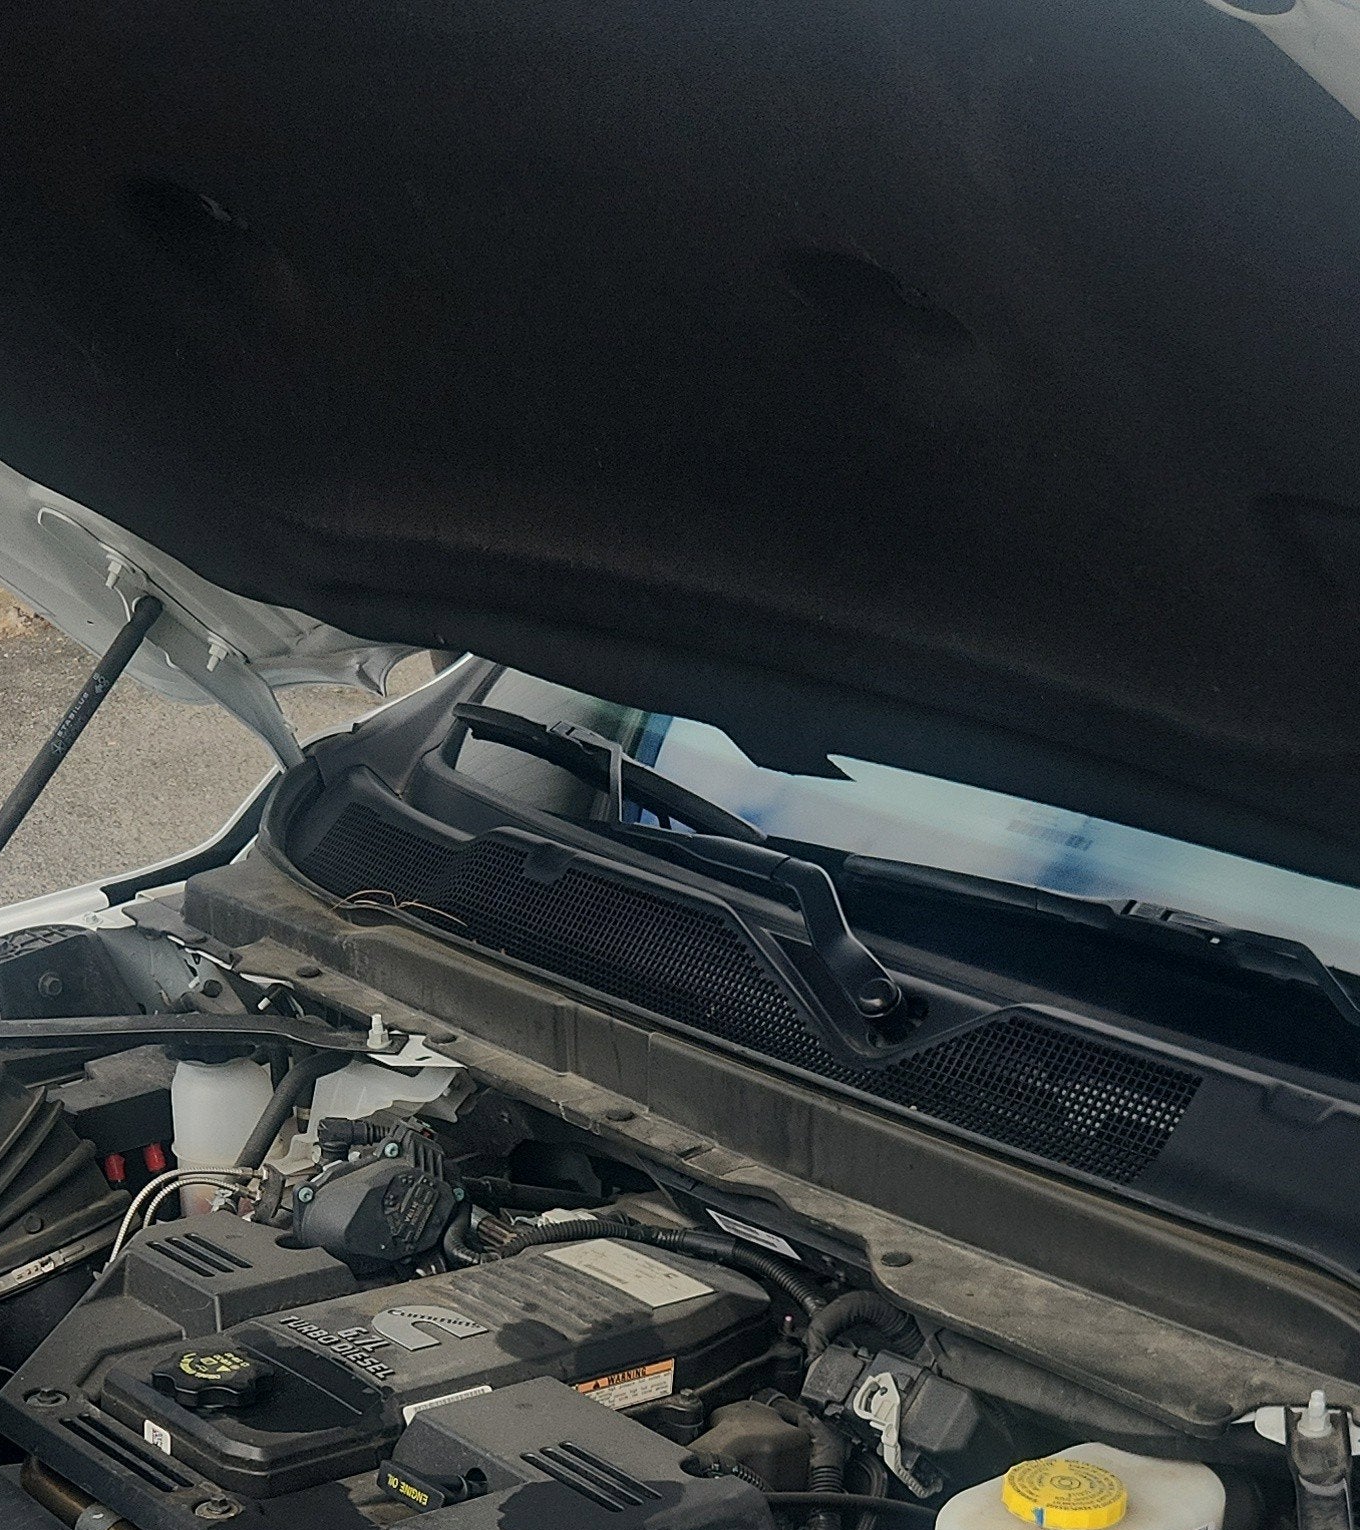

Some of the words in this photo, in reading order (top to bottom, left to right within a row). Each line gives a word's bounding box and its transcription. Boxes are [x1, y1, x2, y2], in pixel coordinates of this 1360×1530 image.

[280, 1315, 338, 1347] TURBO
[330, 1342, 395, 1382] DIESEL
[338, 1326, 390, 1353] 6.7L
[608, 1367, 647, 1387] WARNING
[387, 1473, 399, 1489] OIL
[399, 1482, 429, 1506] ENGINE
